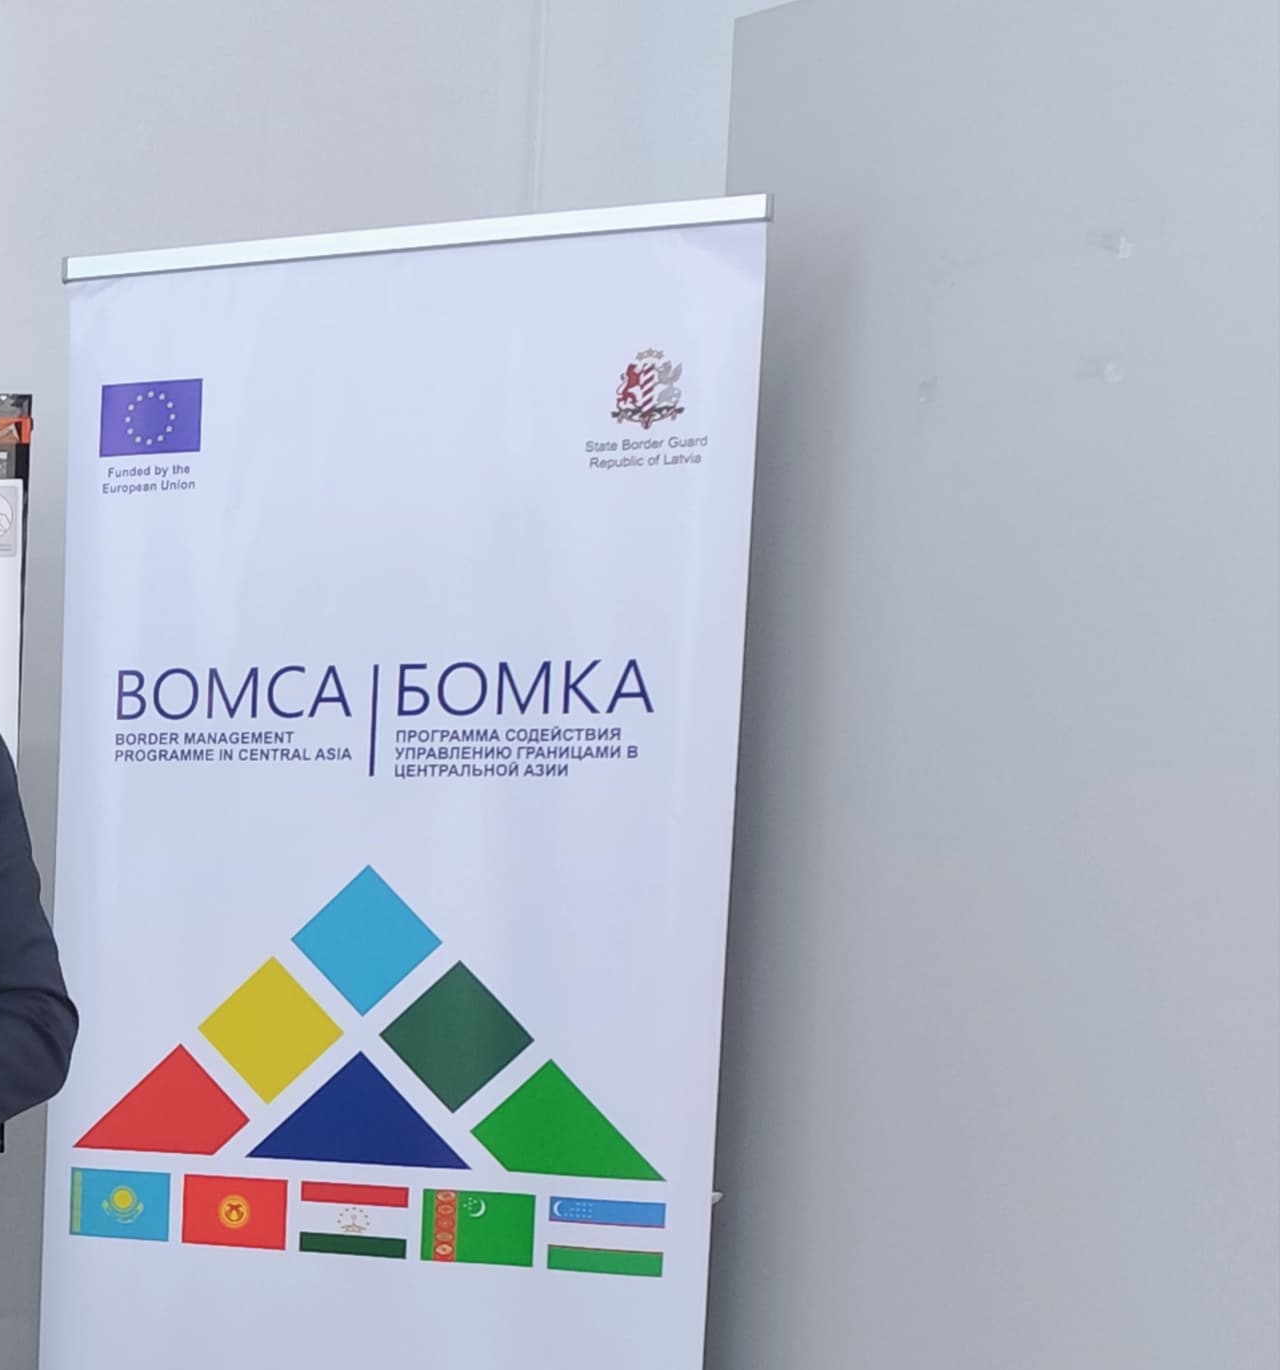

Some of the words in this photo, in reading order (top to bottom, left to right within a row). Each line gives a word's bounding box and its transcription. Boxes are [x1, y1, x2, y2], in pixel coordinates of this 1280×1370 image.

[586, 441, 617, 452] State
[622, 439, 664, 450] Border
[668, 435, 708, 448] Guard
[590, 456, 644, 469] Republic
[648, 454, 660, 466] of
[664, 453, 701, 465] Latvia
[108, 466, 151, 478] Funded
[155, 465, 168, 477] by
[172, 464, 190, 475] the
[102, 482, 157, 494] European
[161, 480, 195, 491] Union
[117, 665, 352, 720] BOMCA
[397, 659, 655, 716] БОМКА
[115, 733, 179, 745] BORDER
[184, 731, 294, 745] MANAGEMENT
[396, 729, 500, 743] ПРОГРАММА
[505, 726, 621, 742] СОДЕЙСТВИЯ
[115, 749, 214, 762] PROGRAMME
[219, 749, 233, 761] IN
[239, 748, 311, 761] CENTRAL
[315, 748, 352, 760] ASIA
[395, 746, 512, 760] УПРАВЛЕНИЮ
[517, 746, 621, 760] ГРАНИЦАМИ
[627, 745, 638, 759] В
[394, 762, 519, 778] ЦЕНТРАЛЬНОЙ
[524, 764, 568, 777] АЗИИ
